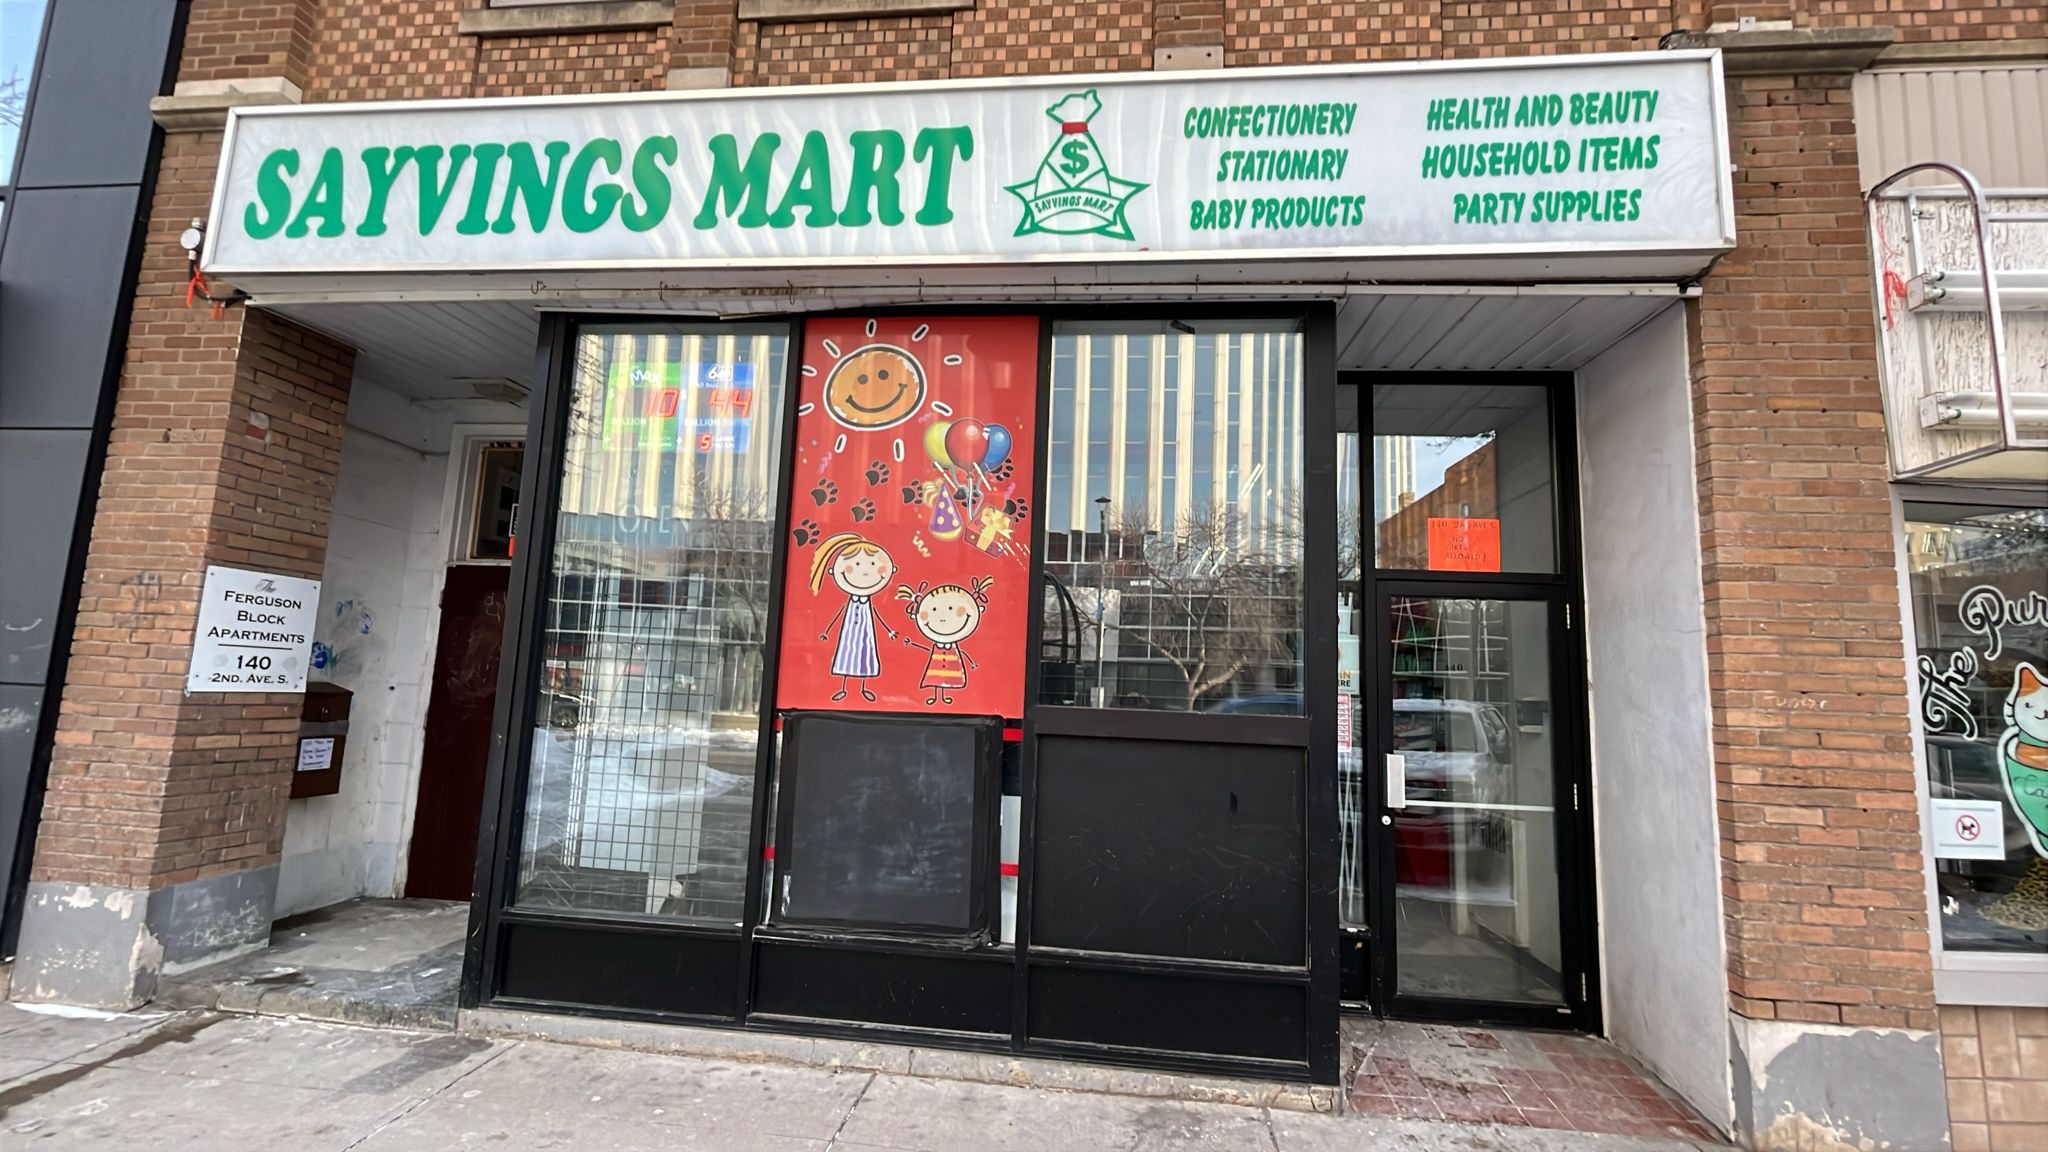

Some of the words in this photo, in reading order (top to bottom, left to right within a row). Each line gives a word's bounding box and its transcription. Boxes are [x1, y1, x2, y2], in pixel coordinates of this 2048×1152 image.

[1183, 102, 1357, 139] CONFECTIONERY
[1426, 96, 1511, 131] HEALTH
[1514, 93, 1564, 128] AND
[1569, 90, 1659, 125] BEAUTY
[1216, 148, 1349, 182] STATIONARY
[1421, 138, 1572, 178] HOUSEHOLD
[1578, 134, 1661, 173] ITEMS
[243, 134, 678, 240] SAYVINGS
[693, 125, 975, 231] MART
[1034, 195, 1082, 214] SAYVINGS
[1082, 196, 1115, 213] MART
[1189, 197, 1247, 231] BABY
[1251, 194, 1366, 230] PRODUCTS
[1453, 190, 1526, 224] PARTY
[1530, 187, 1642, 223] SUPPLIES
[646, 387, 681, 418] 10
[710, 387, 753, 418] 44
[255, 578, 277, 593] The
[211, 672, 243, 684] 2ND.
[277, 674, 289, 684] S.
[237, 655, 272, 670] 140
[1917, 646, 1979, 741] The
